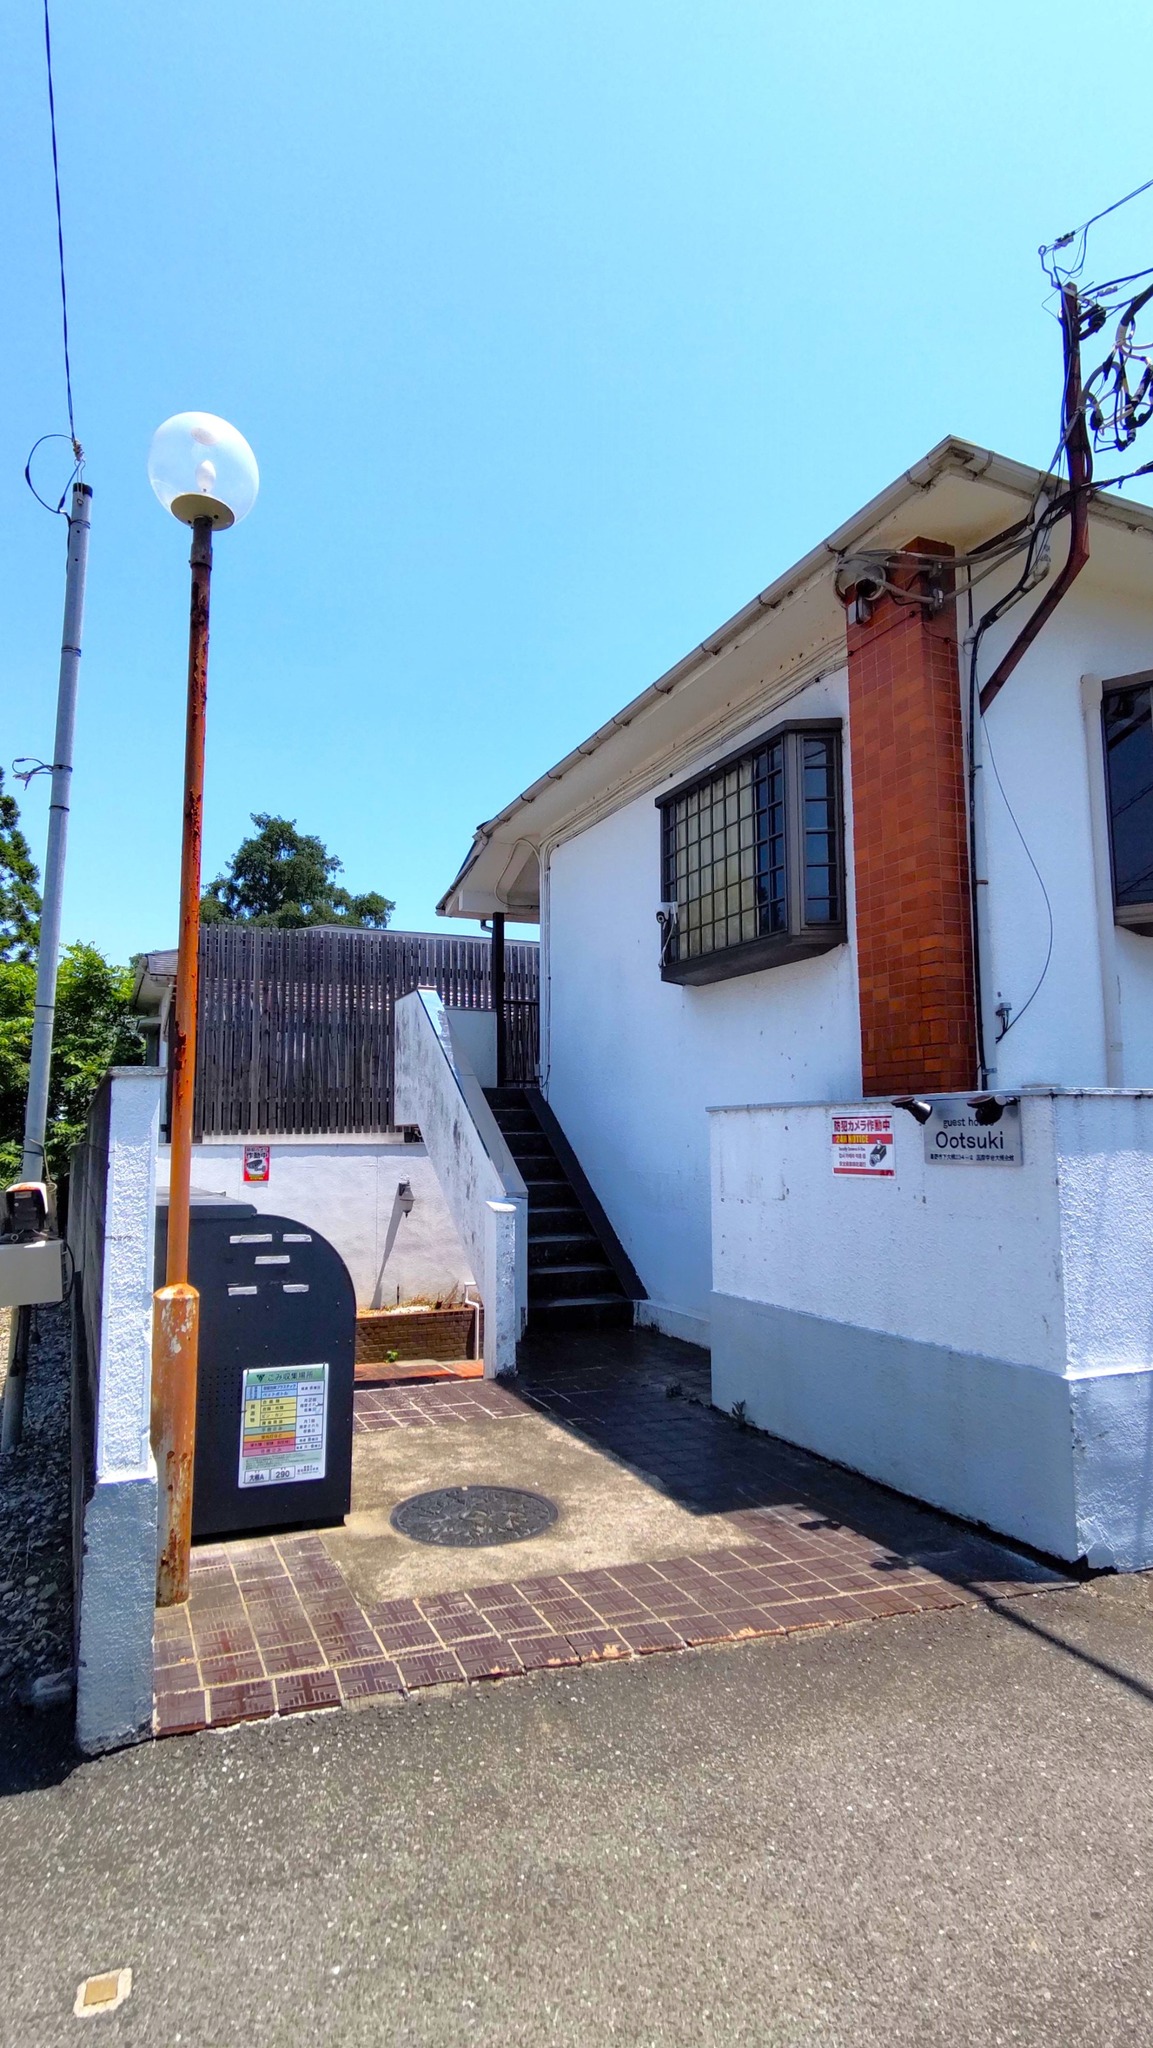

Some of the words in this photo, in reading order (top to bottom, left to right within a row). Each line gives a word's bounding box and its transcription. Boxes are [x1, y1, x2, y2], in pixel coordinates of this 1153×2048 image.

[834, 1119, 890, 1132] 防犯カメラ作動中
[943, 1118, 966, 1129] guest
[936, 1131, 1004, 1149] Ootsuki
[268, 1371, 313, 1382] ごみ収集場所
[275, 1471, 291, 1479] 290
